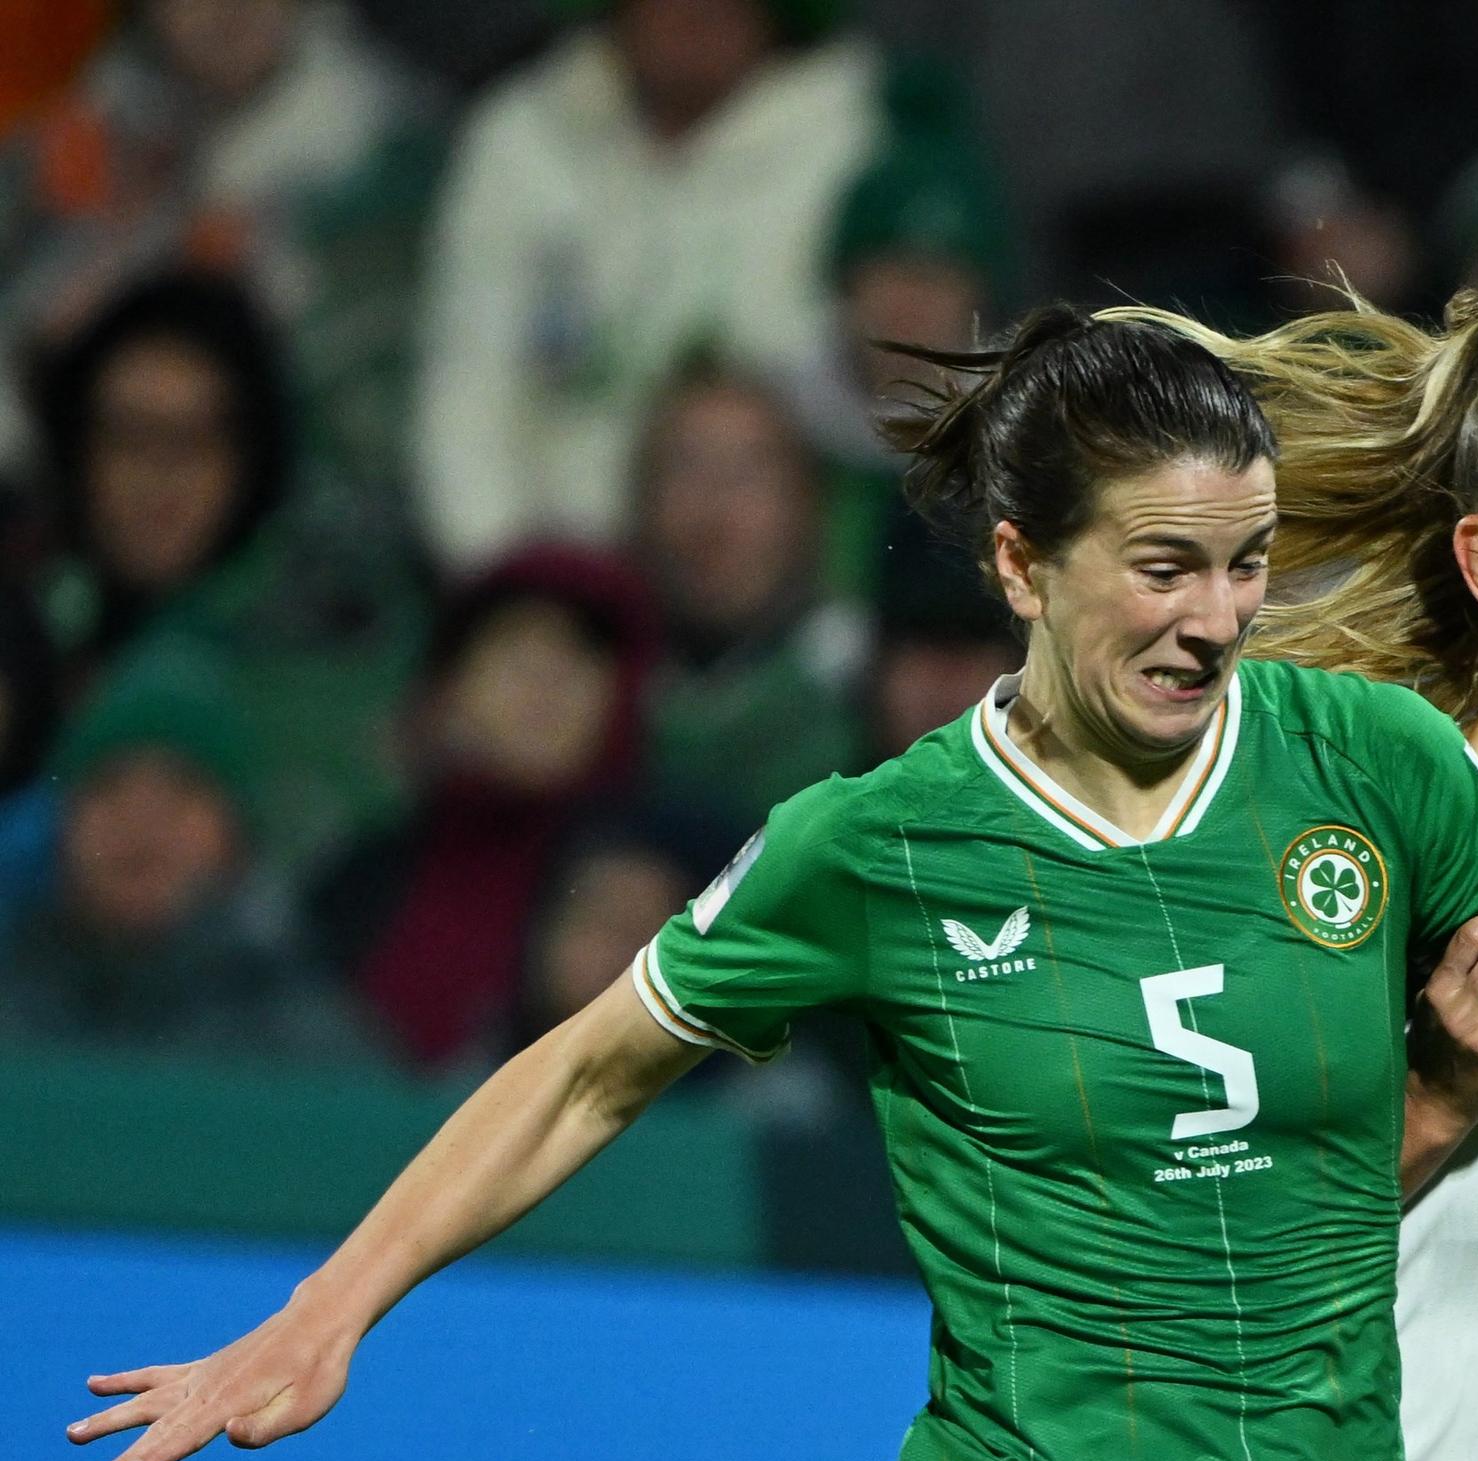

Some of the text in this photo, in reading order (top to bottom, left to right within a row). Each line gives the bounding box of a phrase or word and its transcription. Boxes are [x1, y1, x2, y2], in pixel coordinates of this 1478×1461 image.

[1285, 833, 1371, 881] IRELAND
[955, 958, 1037, 982] CASTORE
[1139, 963, 1260, 1140] 5
[1173, 1140, 1250, 1161] v Canada
[1154, 1156, 1274, 1183] 26th July 2023
